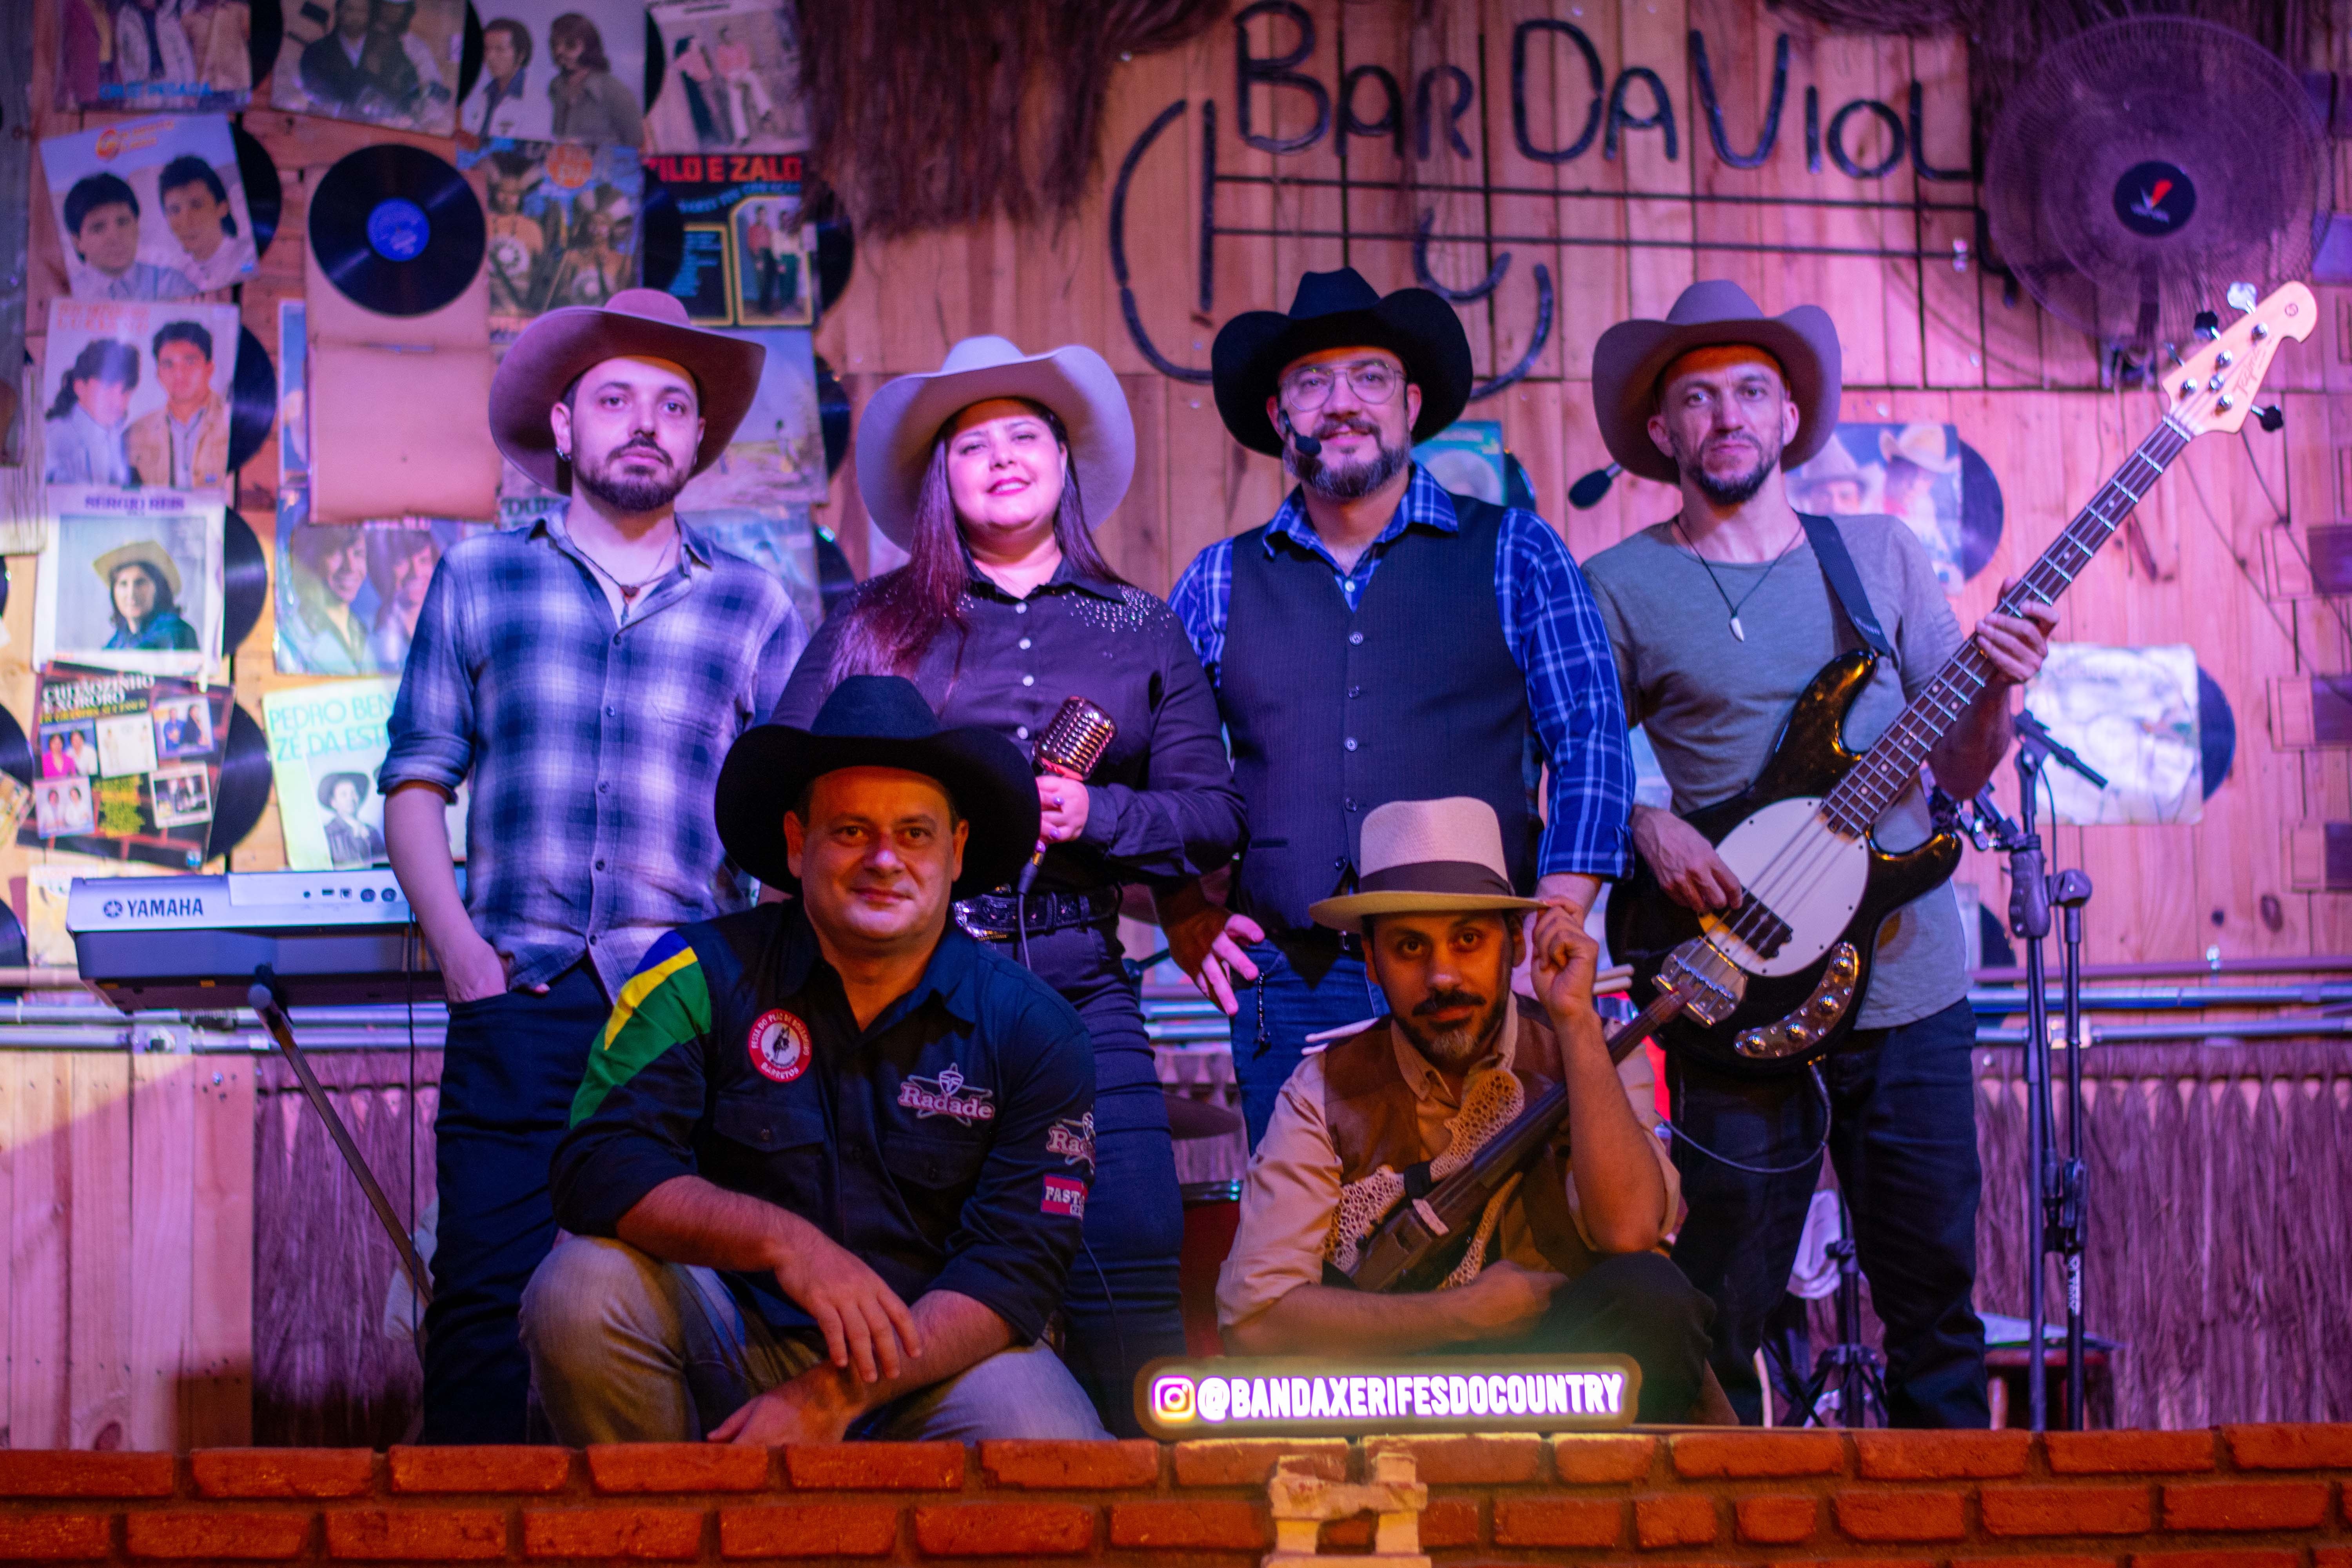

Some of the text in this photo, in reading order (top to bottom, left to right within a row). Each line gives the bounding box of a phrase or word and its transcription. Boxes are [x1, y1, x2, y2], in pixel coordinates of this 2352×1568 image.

[643, 156, 703, 182] ILO
[707, 157, 725, 182] E
[269, 699, 347, 731] PEDRO
[307, 730, 341, 757] DA
[127, 898, 204, 917] YAMAHA
[761, 1061, 799, 1079] BARRETOS
[900, 1085, 994, 1119] Radade
[1198, 1374, 1624, 1422] @BANDAXERIFESDOCOUNTRY
